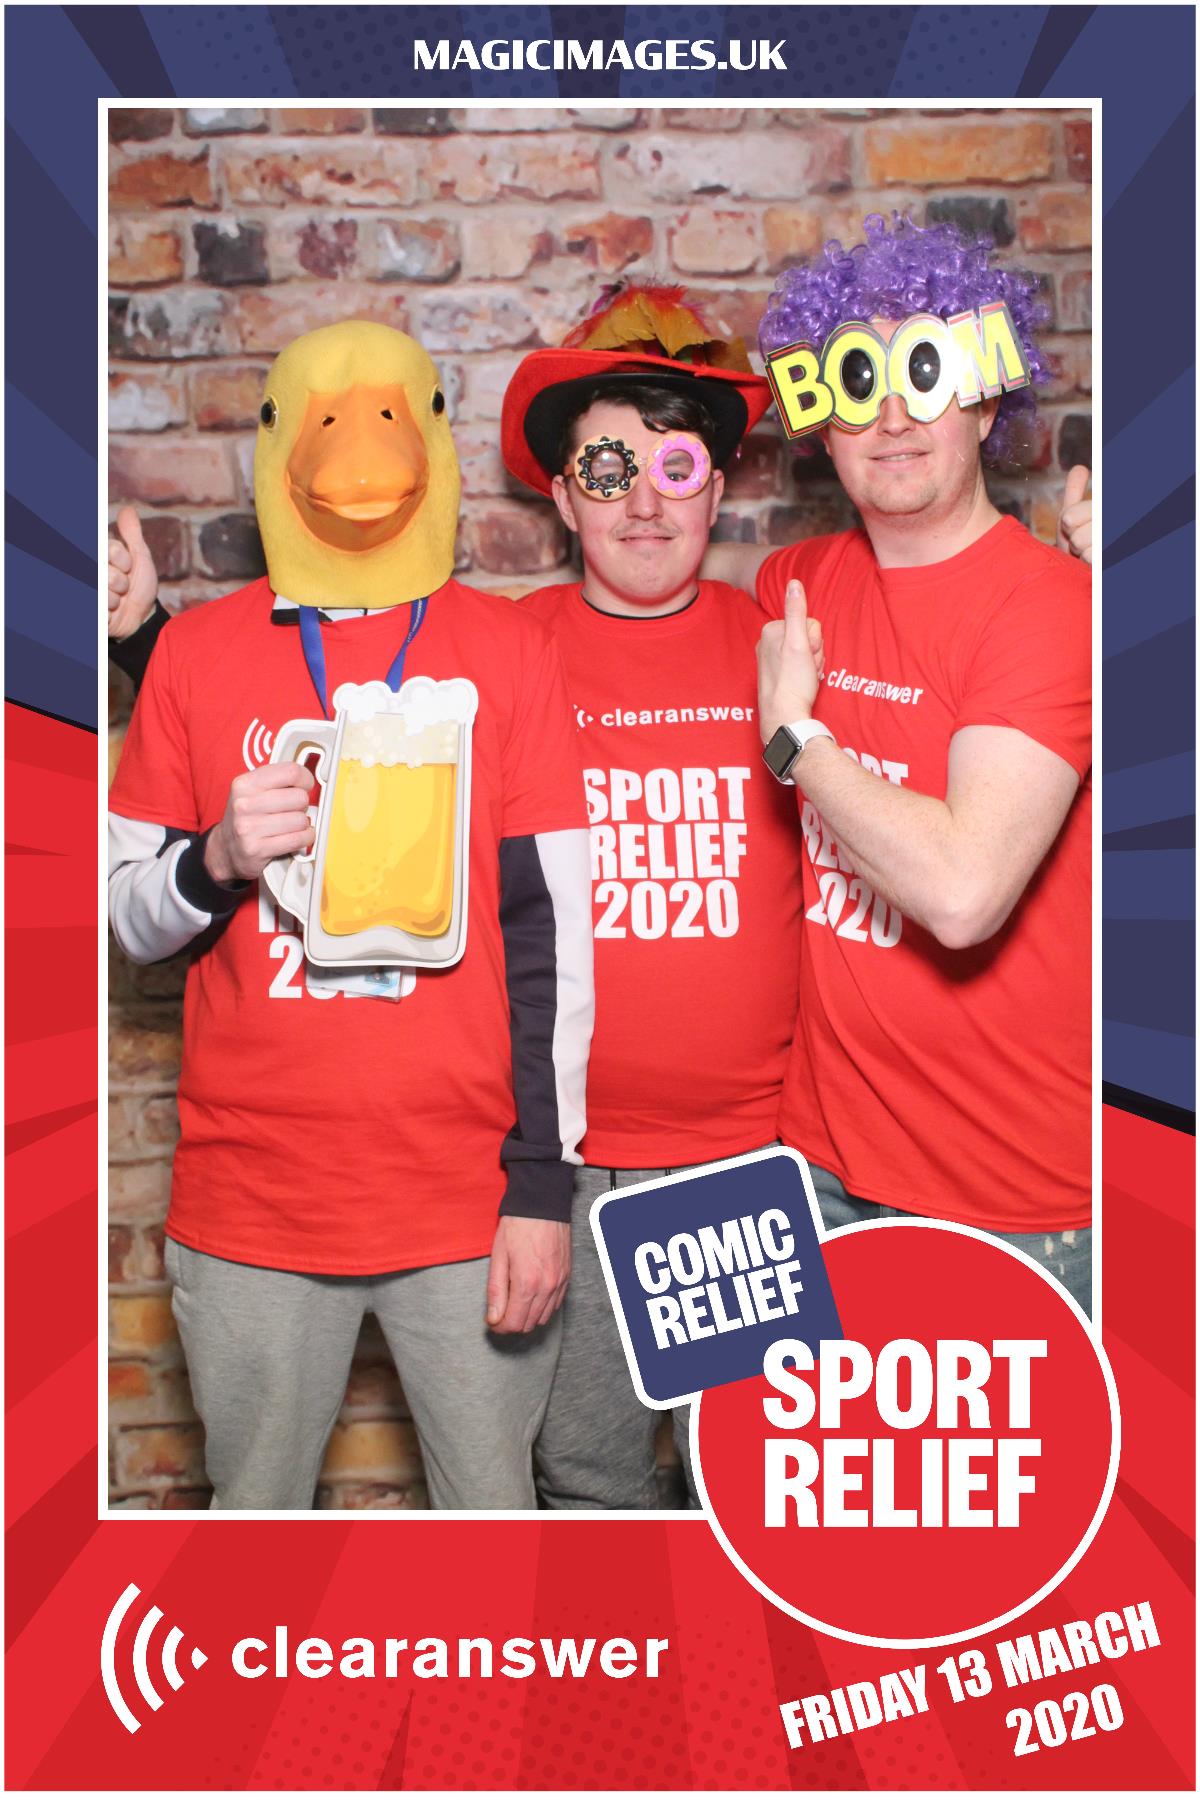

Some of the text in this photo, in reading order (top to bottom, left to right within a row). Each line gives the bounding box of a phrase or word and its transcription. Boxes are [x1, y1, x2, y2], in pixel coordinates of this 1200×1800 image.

[765, 302, 1032, 439] BOOM
[827, 668, 924, 705] clearanswer
[601, 705, 755, 728] clearanswer
[583, 766, 752, 825] SPORT
[591, 823, 748, 881] RELIEF
[594, 878, 740, 940] 2020
